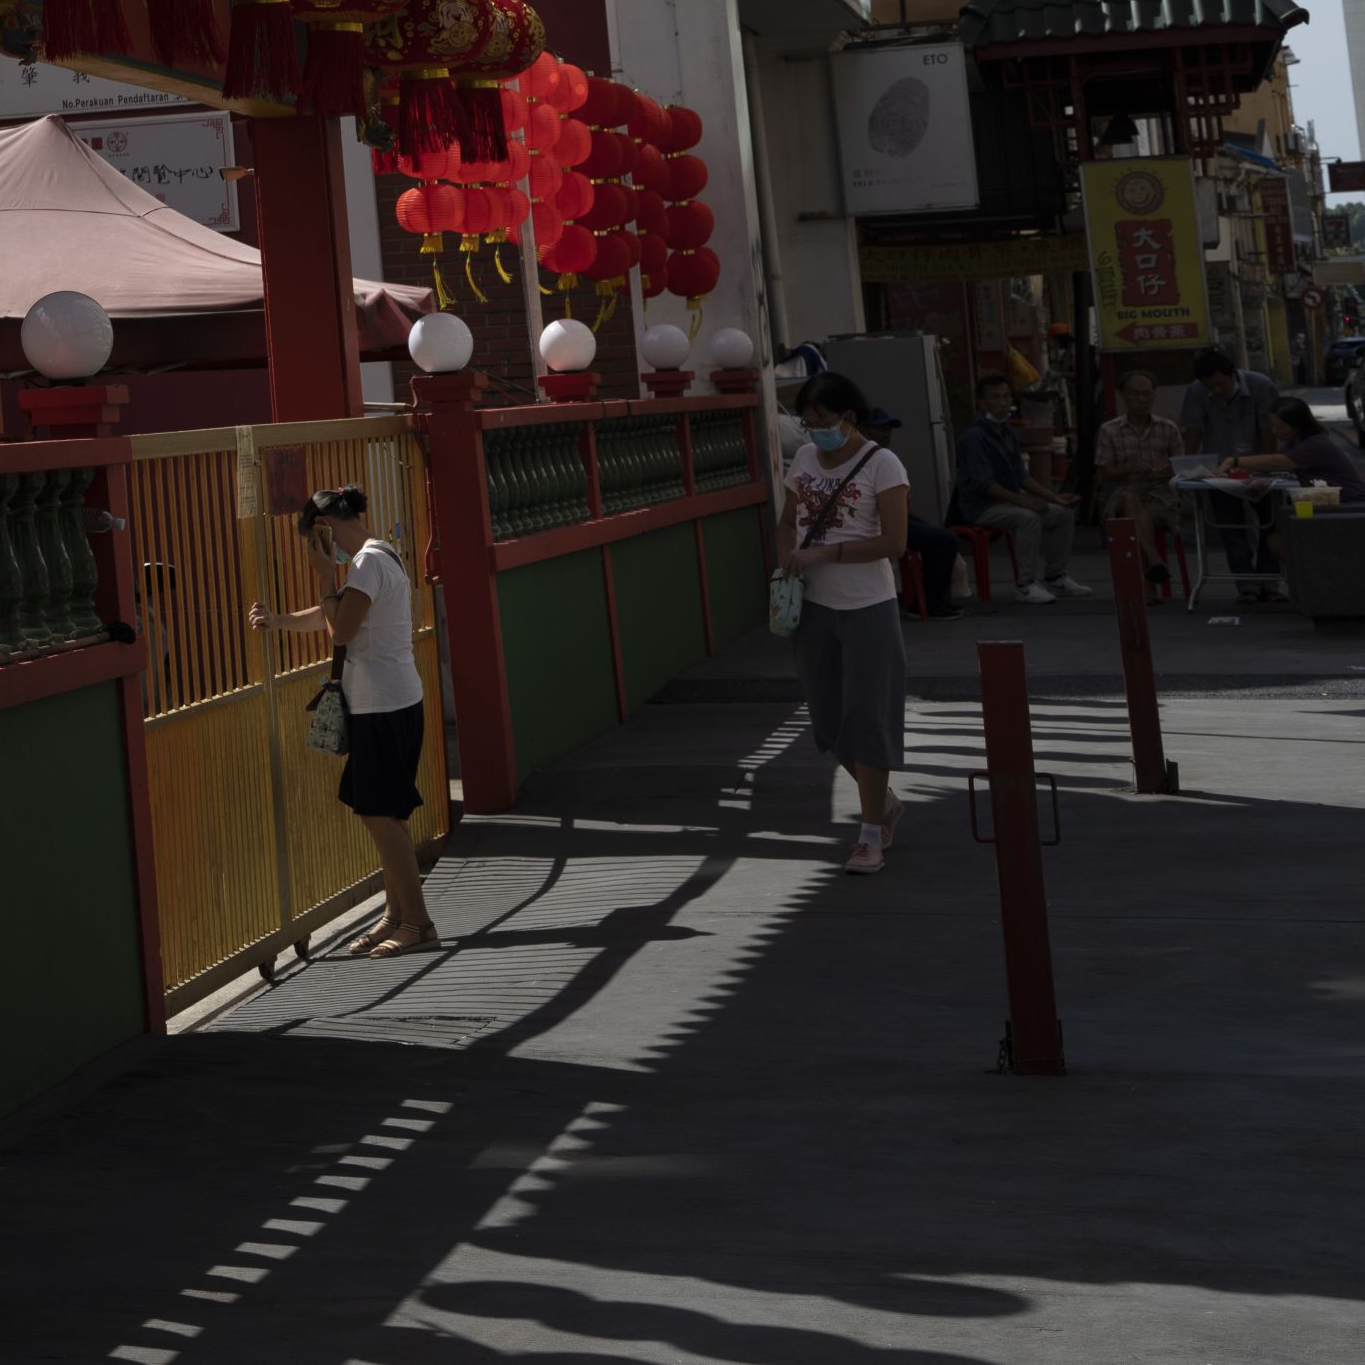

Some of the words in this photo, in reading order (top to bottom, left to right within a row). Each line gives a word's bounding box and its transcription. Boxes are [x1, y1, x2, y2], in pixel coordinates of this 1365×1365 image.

[922, 53, 949, 66] ETO
[62, 97, 115, 111] No.Perakuan
[117, 91, 170, 107] Pendaftaran
[1132, 226, 1169, 296] 大口仔
[1117, 310, 1137, 321] BIG
[1141, 307, 1191, 320] MOUTH
[1133, 324, 1188, 340] 肉骨茶
